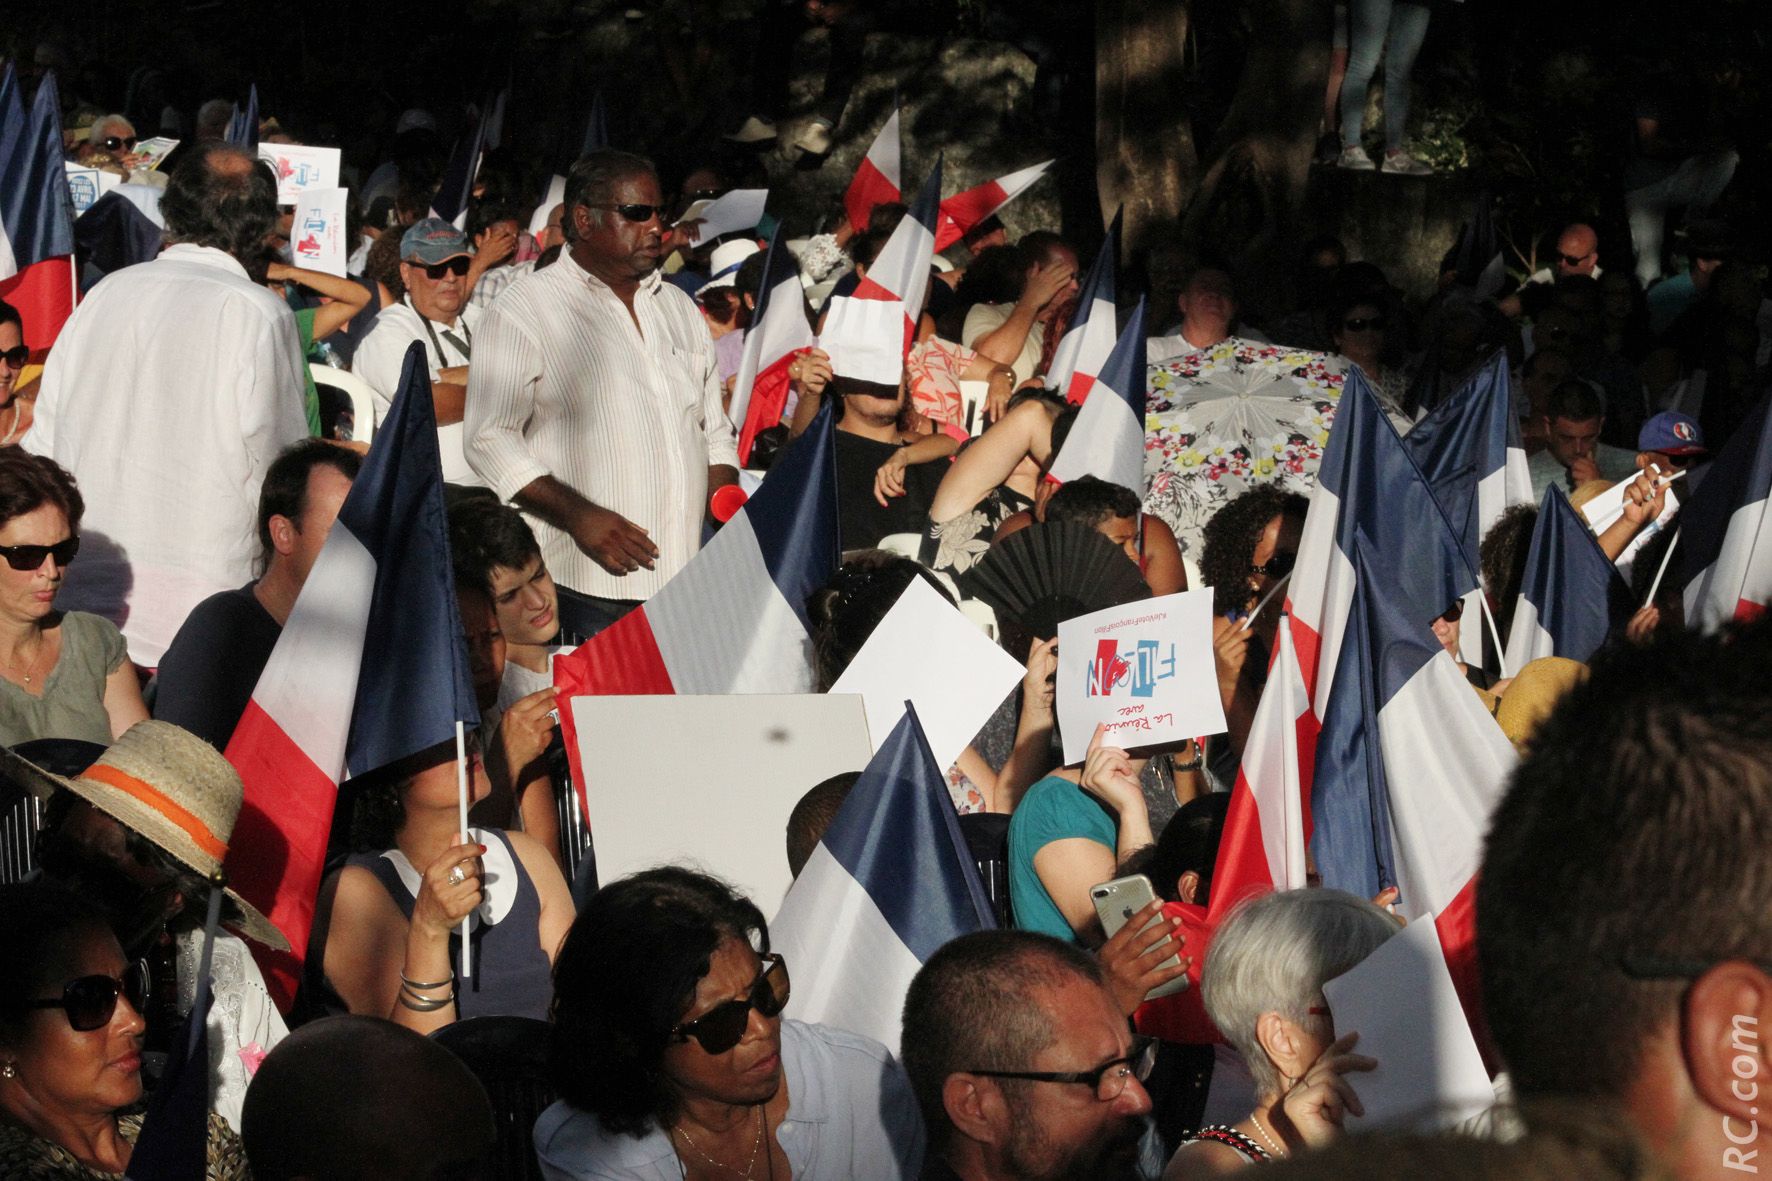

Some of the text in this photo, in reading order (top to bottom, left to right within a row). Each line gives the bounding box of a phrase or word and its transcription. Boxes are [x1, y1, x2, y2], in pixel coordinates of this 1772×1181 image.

[1117, 704, 1144, 715] avec
[1104, 713, 1173, 734] La Réunio
